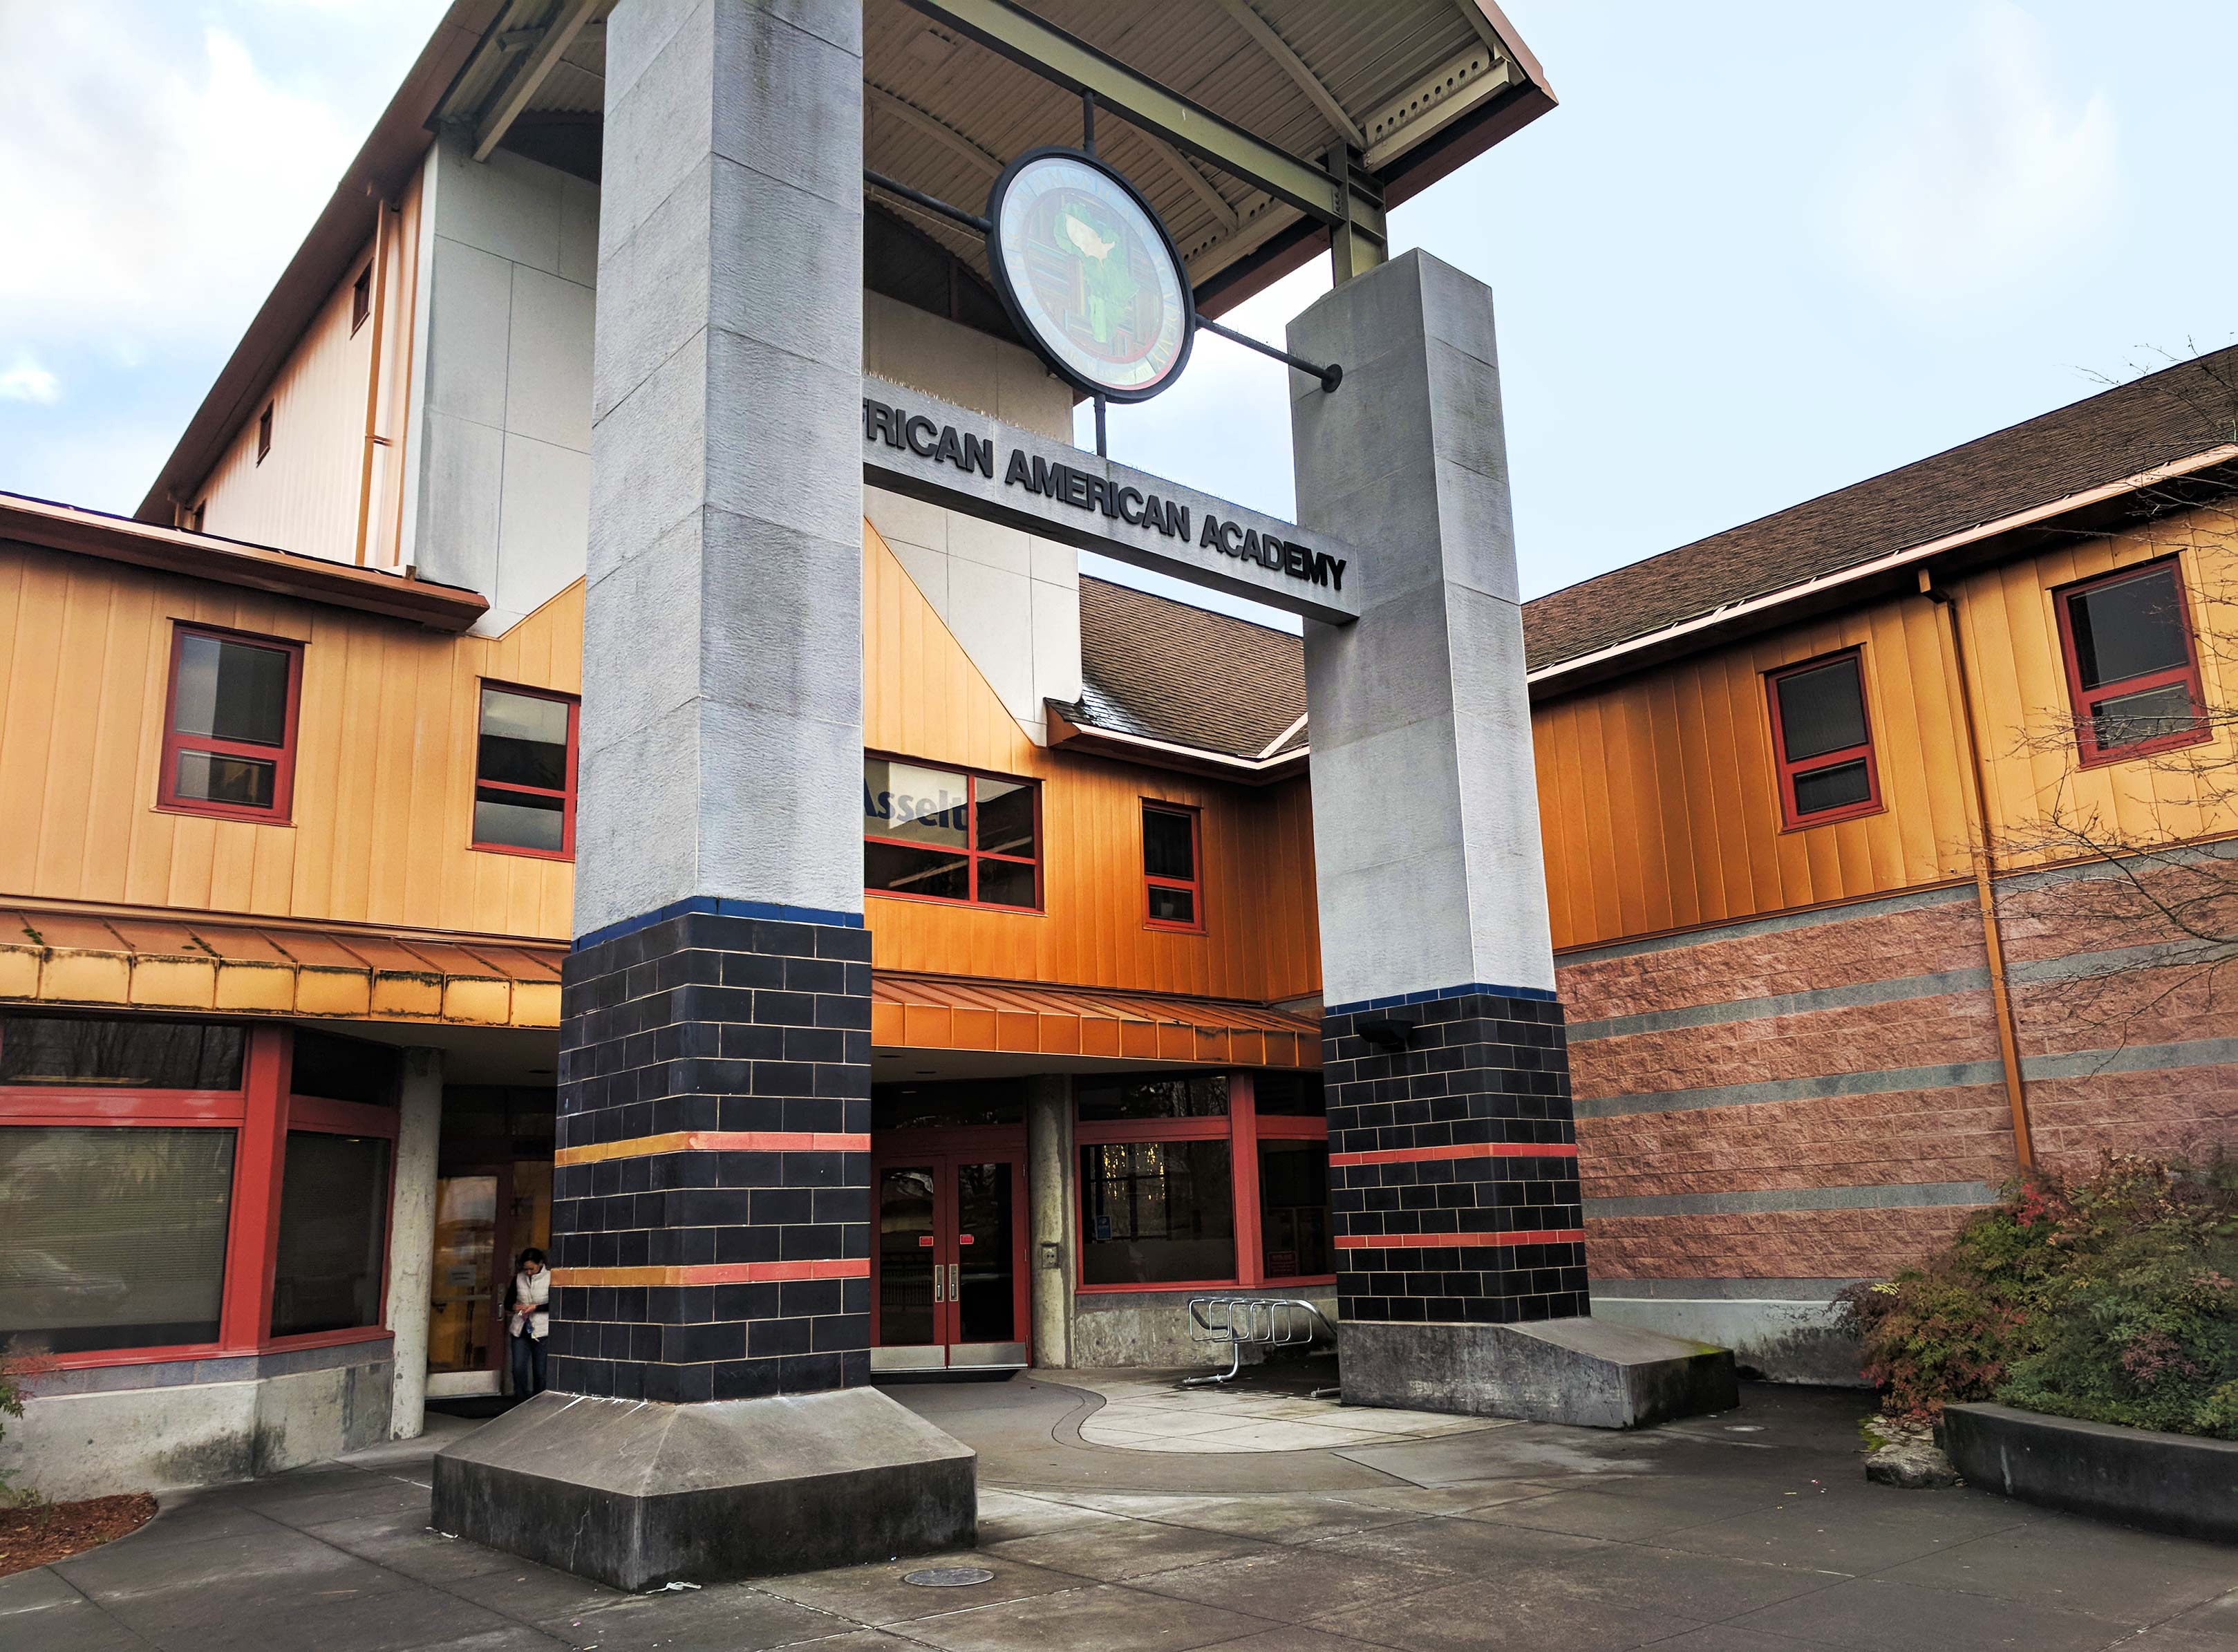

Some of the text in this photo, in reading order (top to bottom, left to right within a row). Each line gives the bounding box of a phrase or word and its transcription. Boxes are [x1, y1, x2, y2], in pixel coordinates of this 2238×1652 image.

[863, 397, 1346, 590] RICAN AMERICAN ACADEMY
